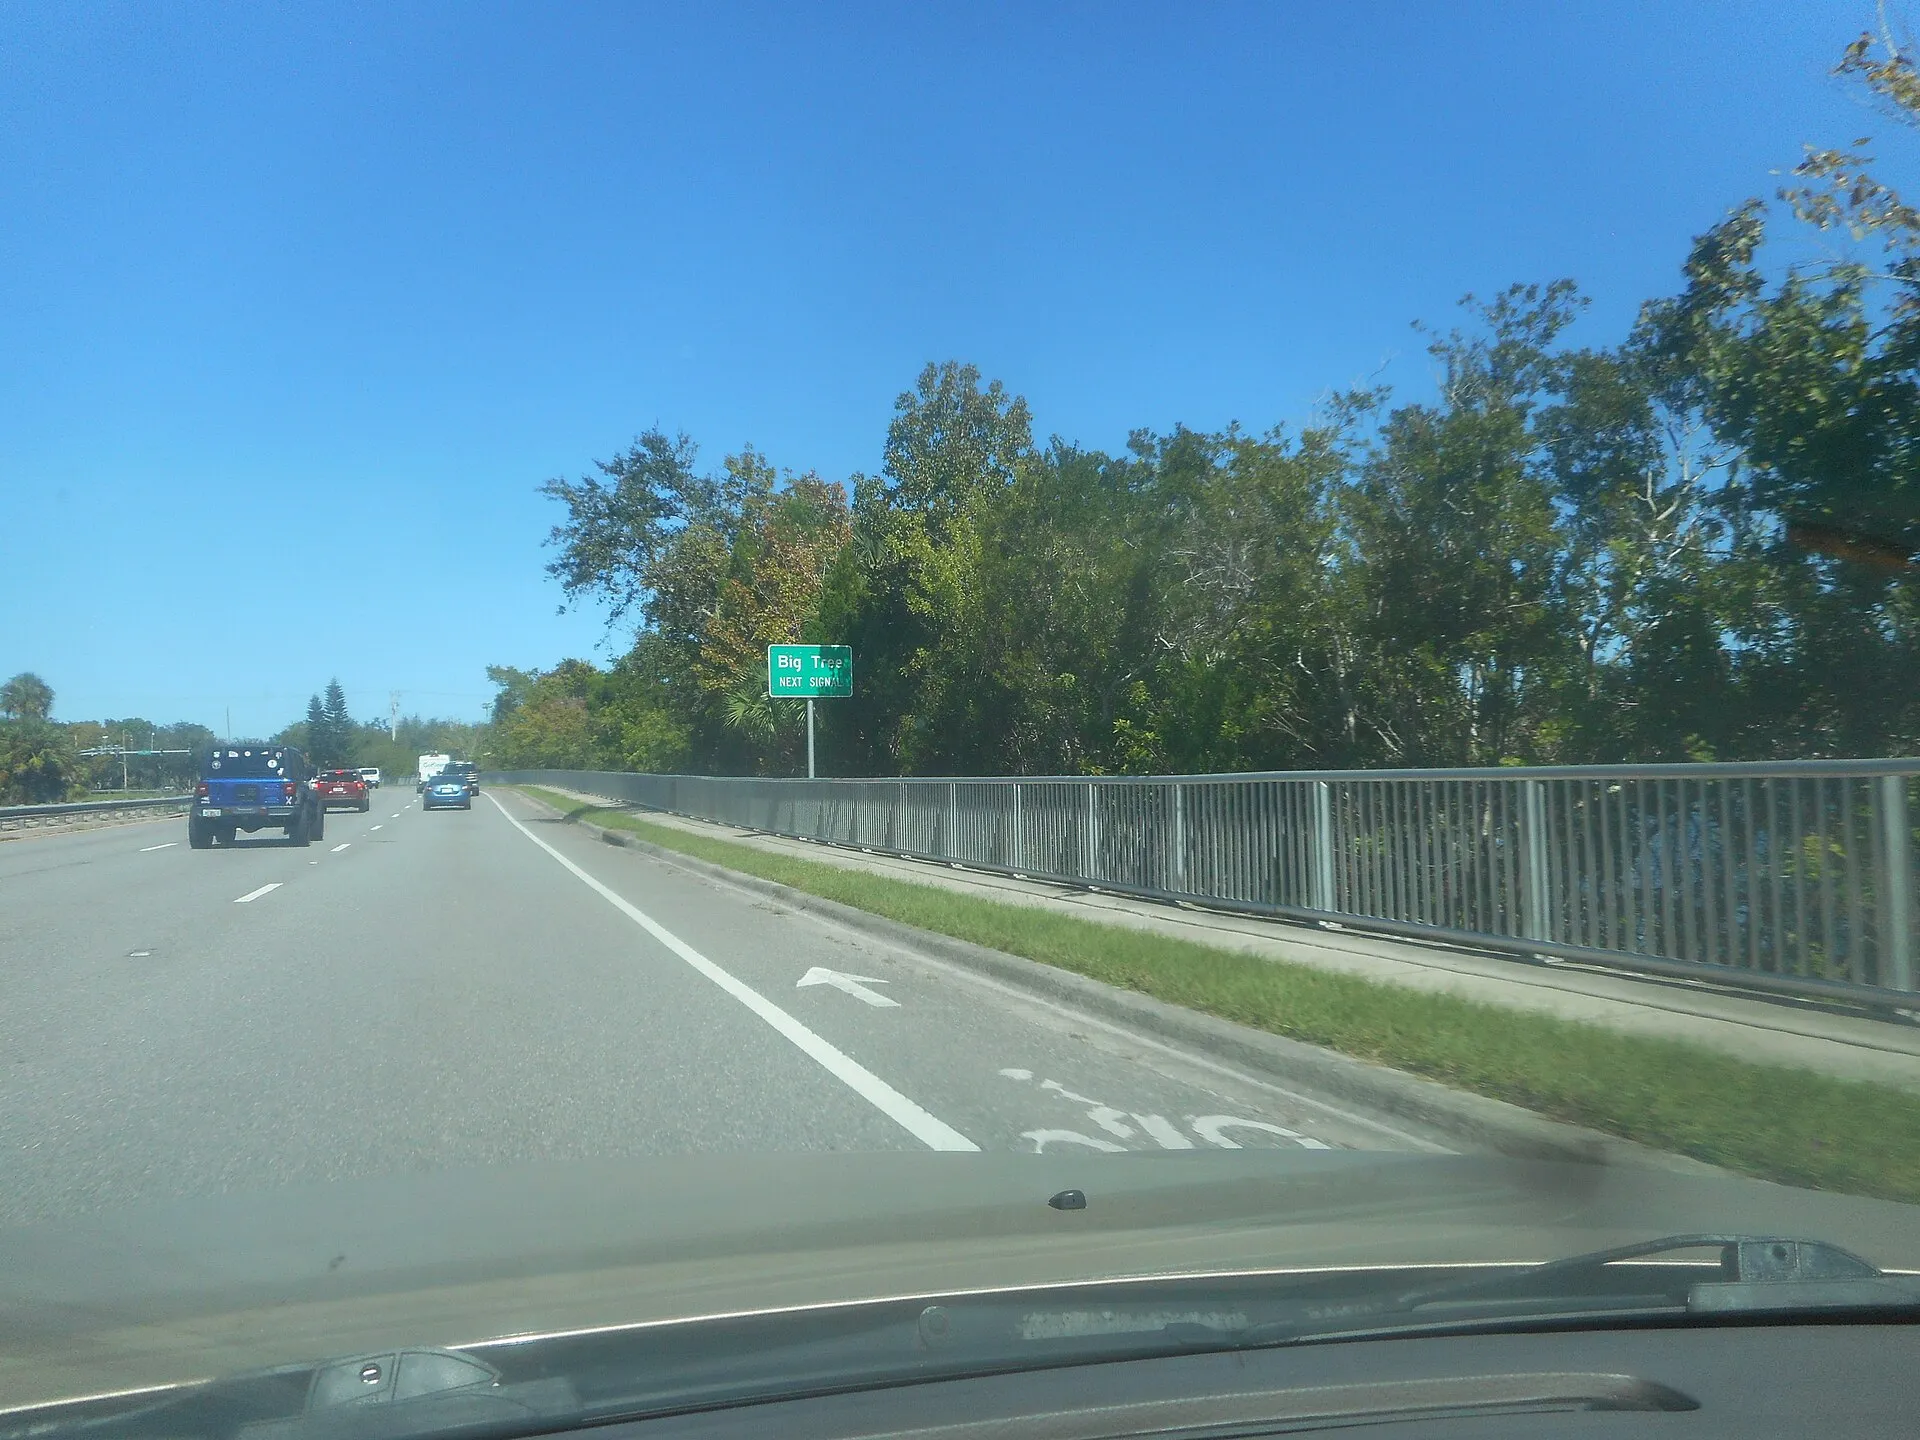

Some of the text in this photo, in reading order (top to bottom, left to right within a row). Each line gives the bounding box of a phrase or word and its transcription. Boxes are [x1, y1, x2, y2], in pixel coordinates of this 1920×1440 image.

[778, 655, 843, 672] Big Tree
[779, 676, 843, 687] NEXT SIGNAL
